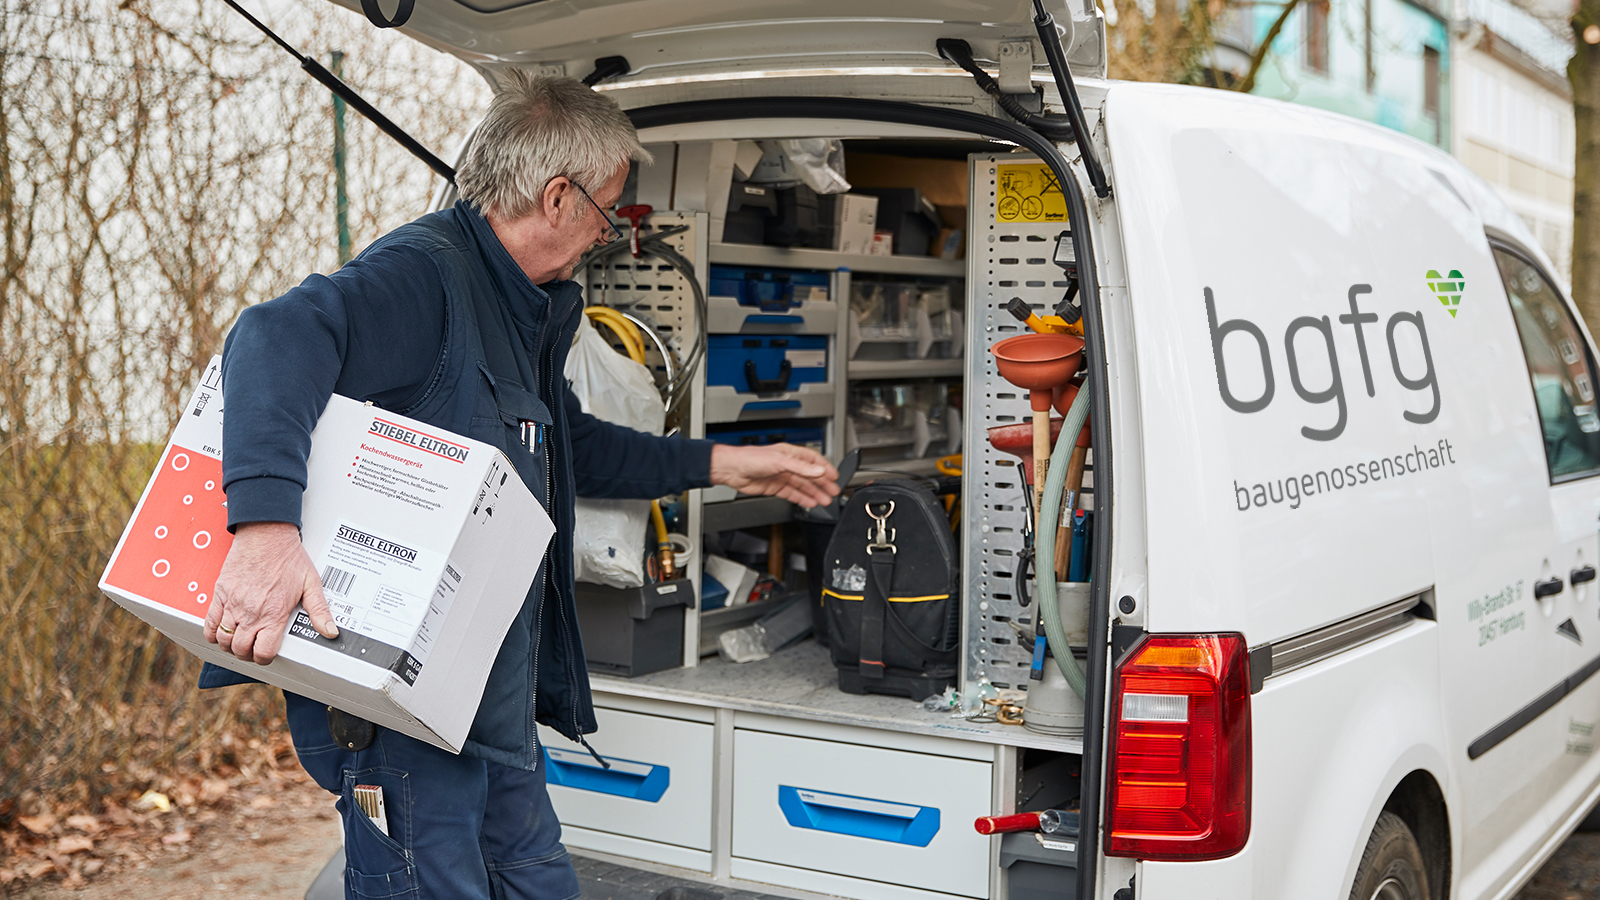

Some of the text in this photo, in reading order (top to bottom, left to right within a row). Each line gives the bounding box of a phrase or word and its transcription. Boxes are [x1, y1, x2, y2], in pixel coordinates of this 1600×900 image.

[1203, 283, 1441, 442] bgfg
[202, 444, 216, 454] EBK
[360, 442, 423, 469] Kochendwassergerät
[370, 420, 470, 462] STIEBEL ELTRON
[1234, 438, 1456, 511] baugenossenschaft
[337, 526, 375, 548] STIEBEL
[377, 541, 418, 562] ELTRON
[292, 624, 320, 639] 074287
